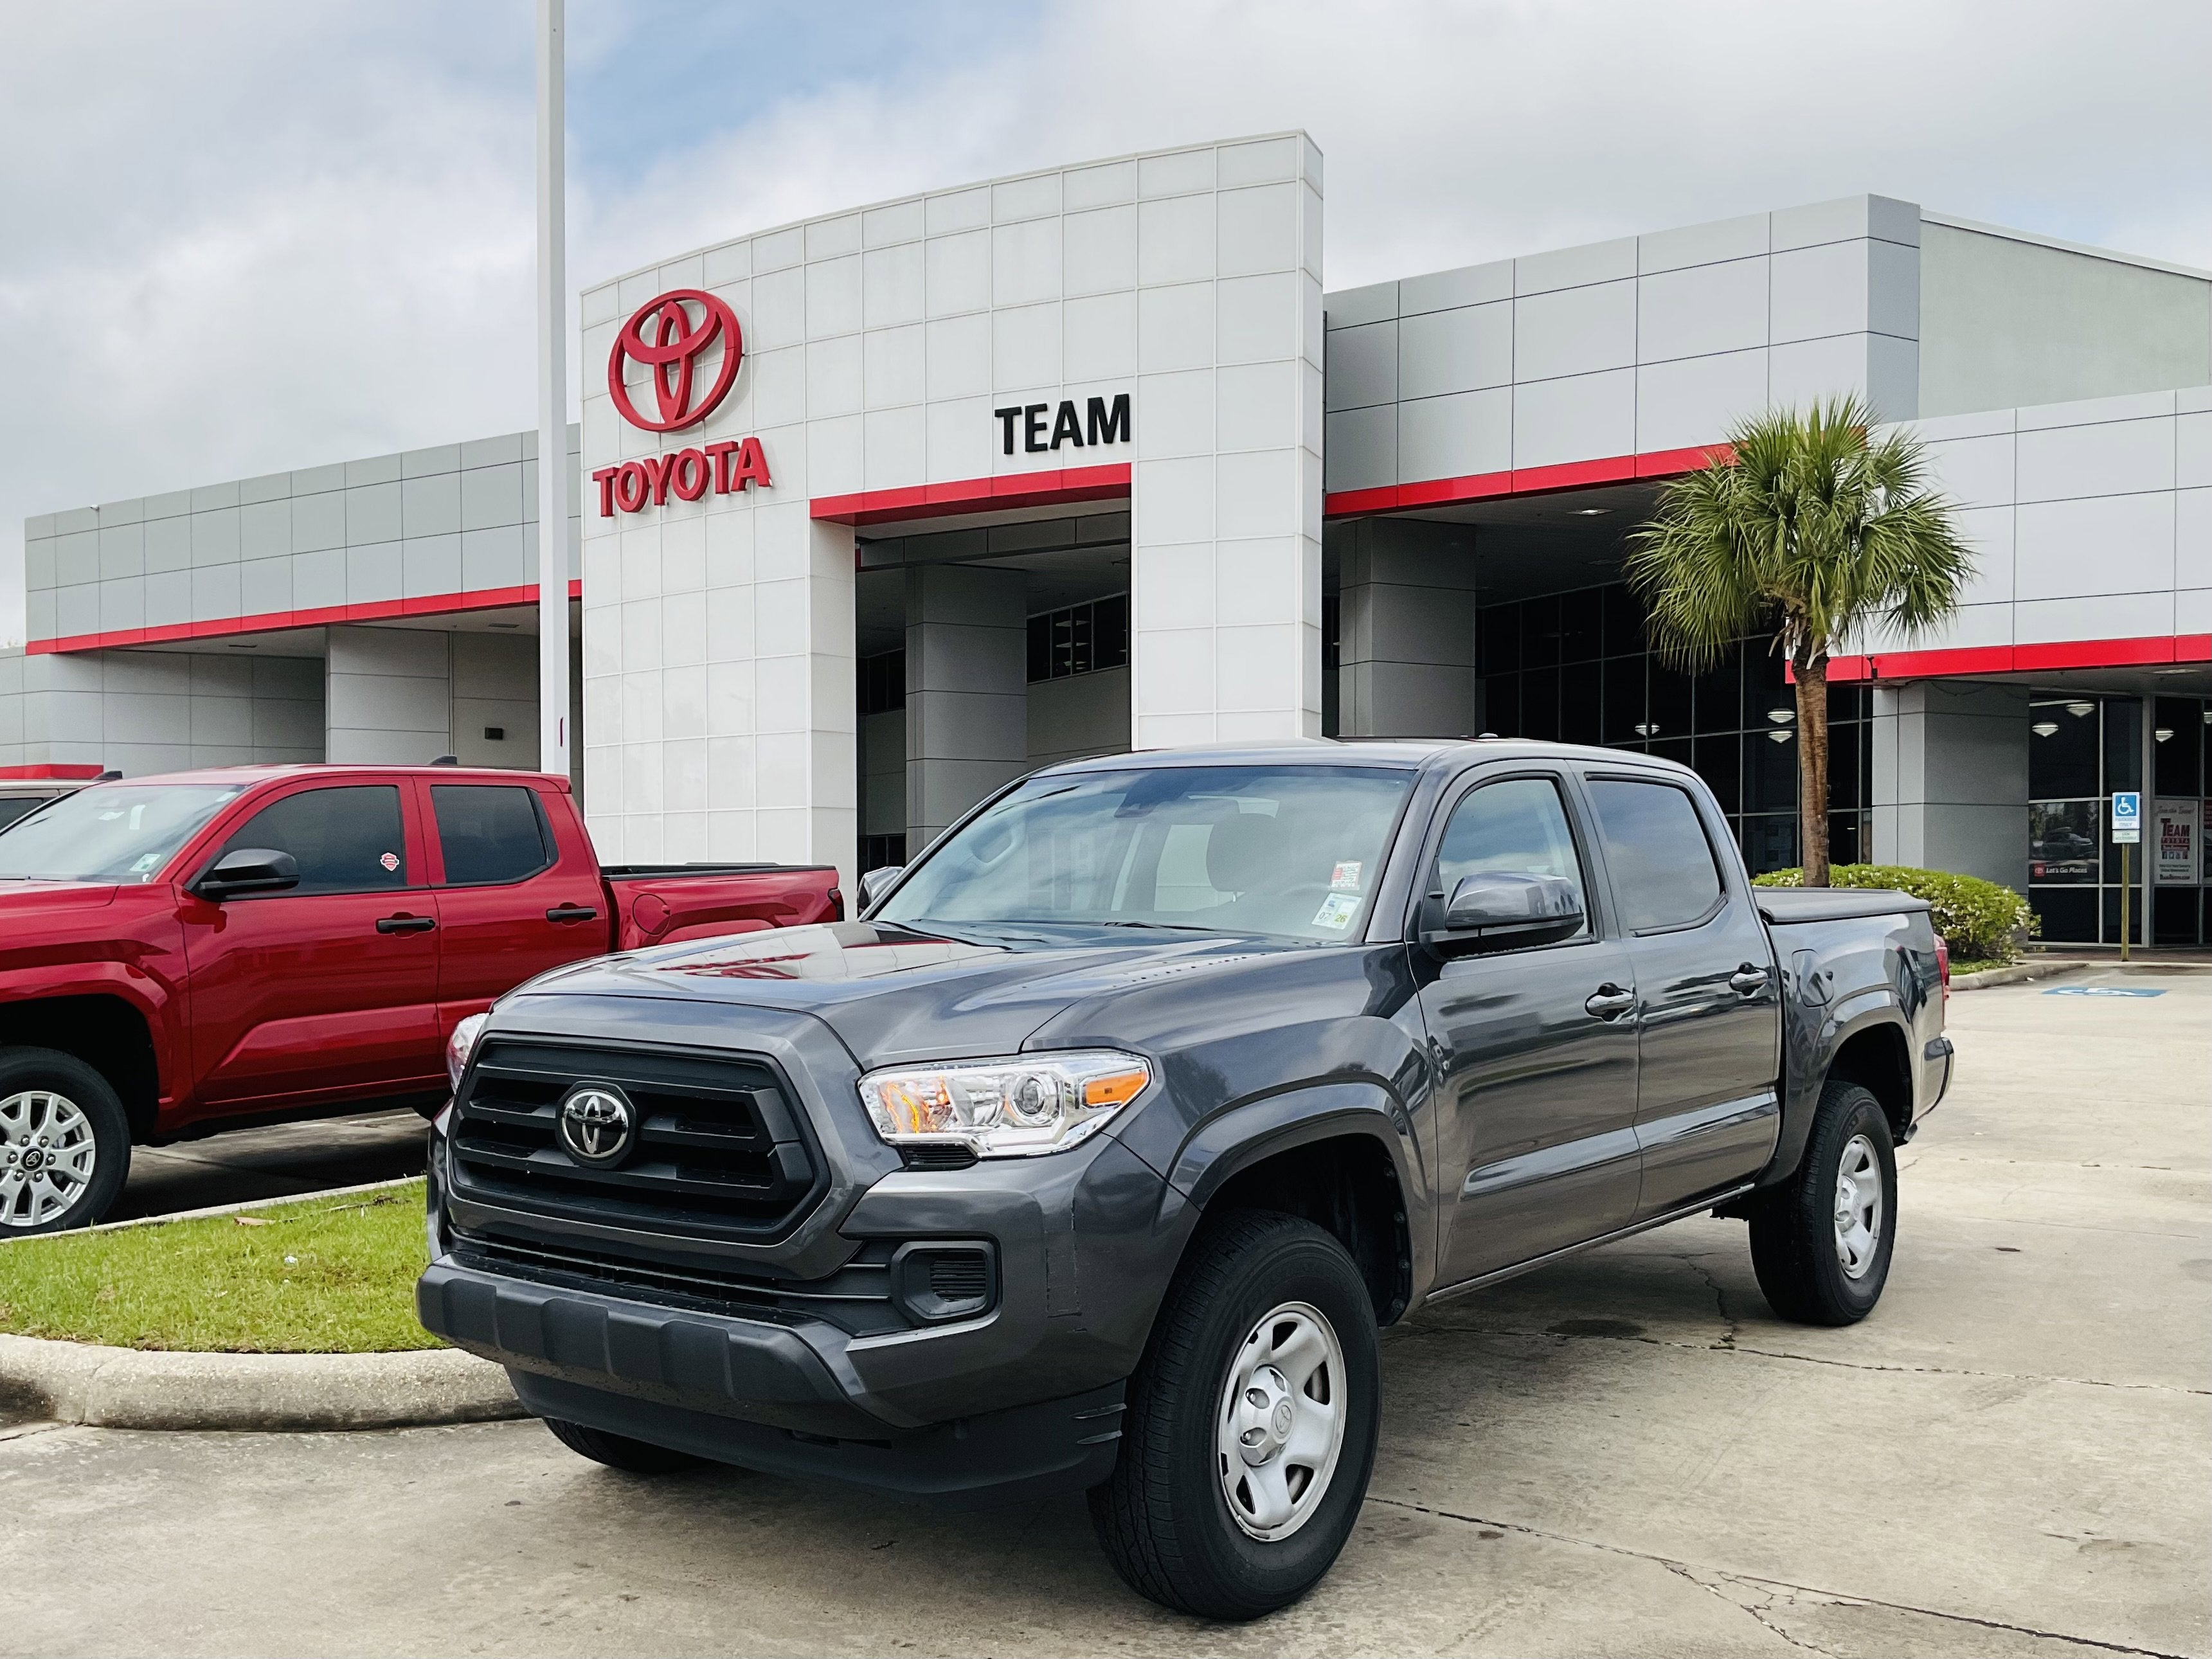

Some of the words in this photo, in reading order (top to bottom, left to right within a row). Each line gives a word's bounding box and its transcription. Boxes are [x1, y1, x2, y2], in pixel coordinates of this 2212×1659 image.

[994, 393, 1130, 454] TEAM
[593, 437, 772, 517] TOYOTA
[1335, 914, 1347, 923] 26
